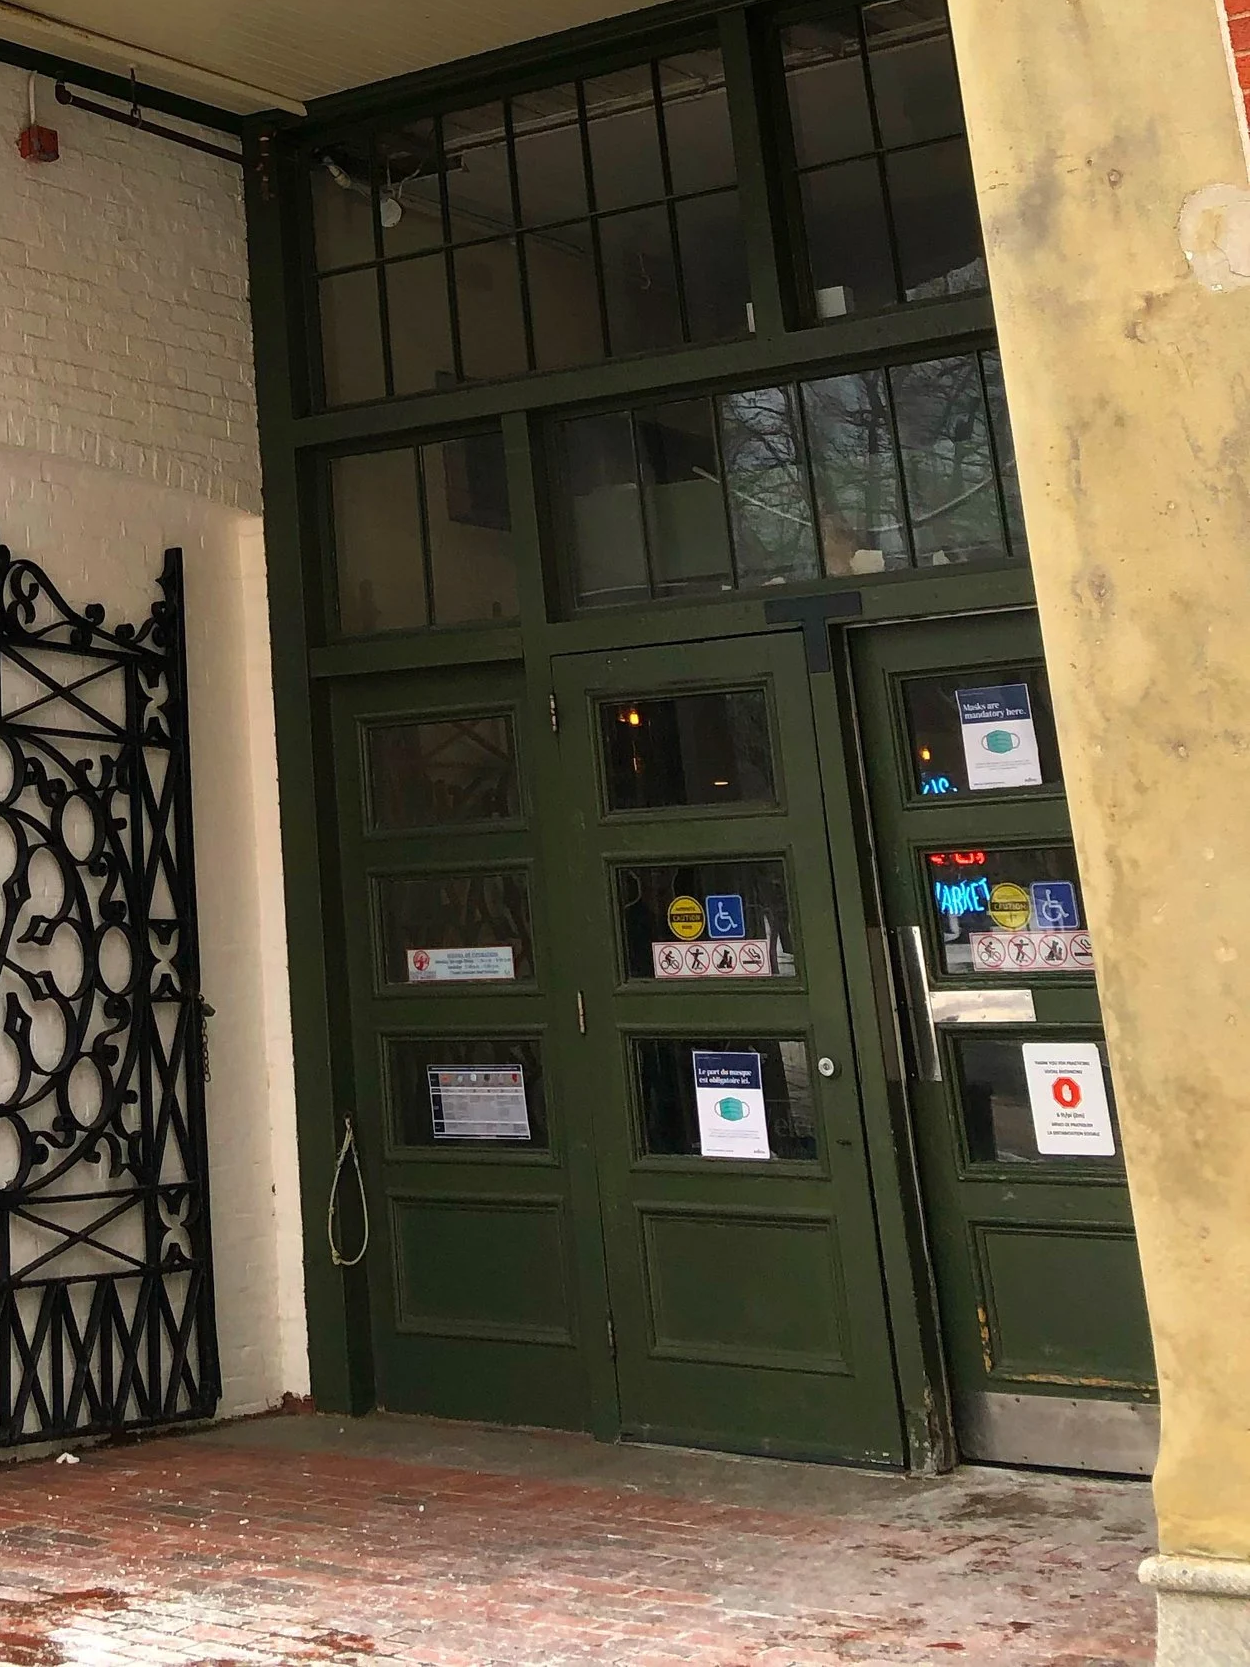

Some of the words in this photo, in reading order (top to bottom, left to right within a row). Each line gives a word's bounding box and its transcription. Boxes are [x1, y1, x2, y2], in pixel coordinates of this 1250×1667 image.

[963, 702, 986, 711] Masks
[987, 702, 1000, 710] are
[964, 710, 1005, 720] mandatory
[1006, 708, 1027, 717] here.
[672, 914, 701, 922] CAUTION
[708, 1077, 740, 1086] obligatoire
